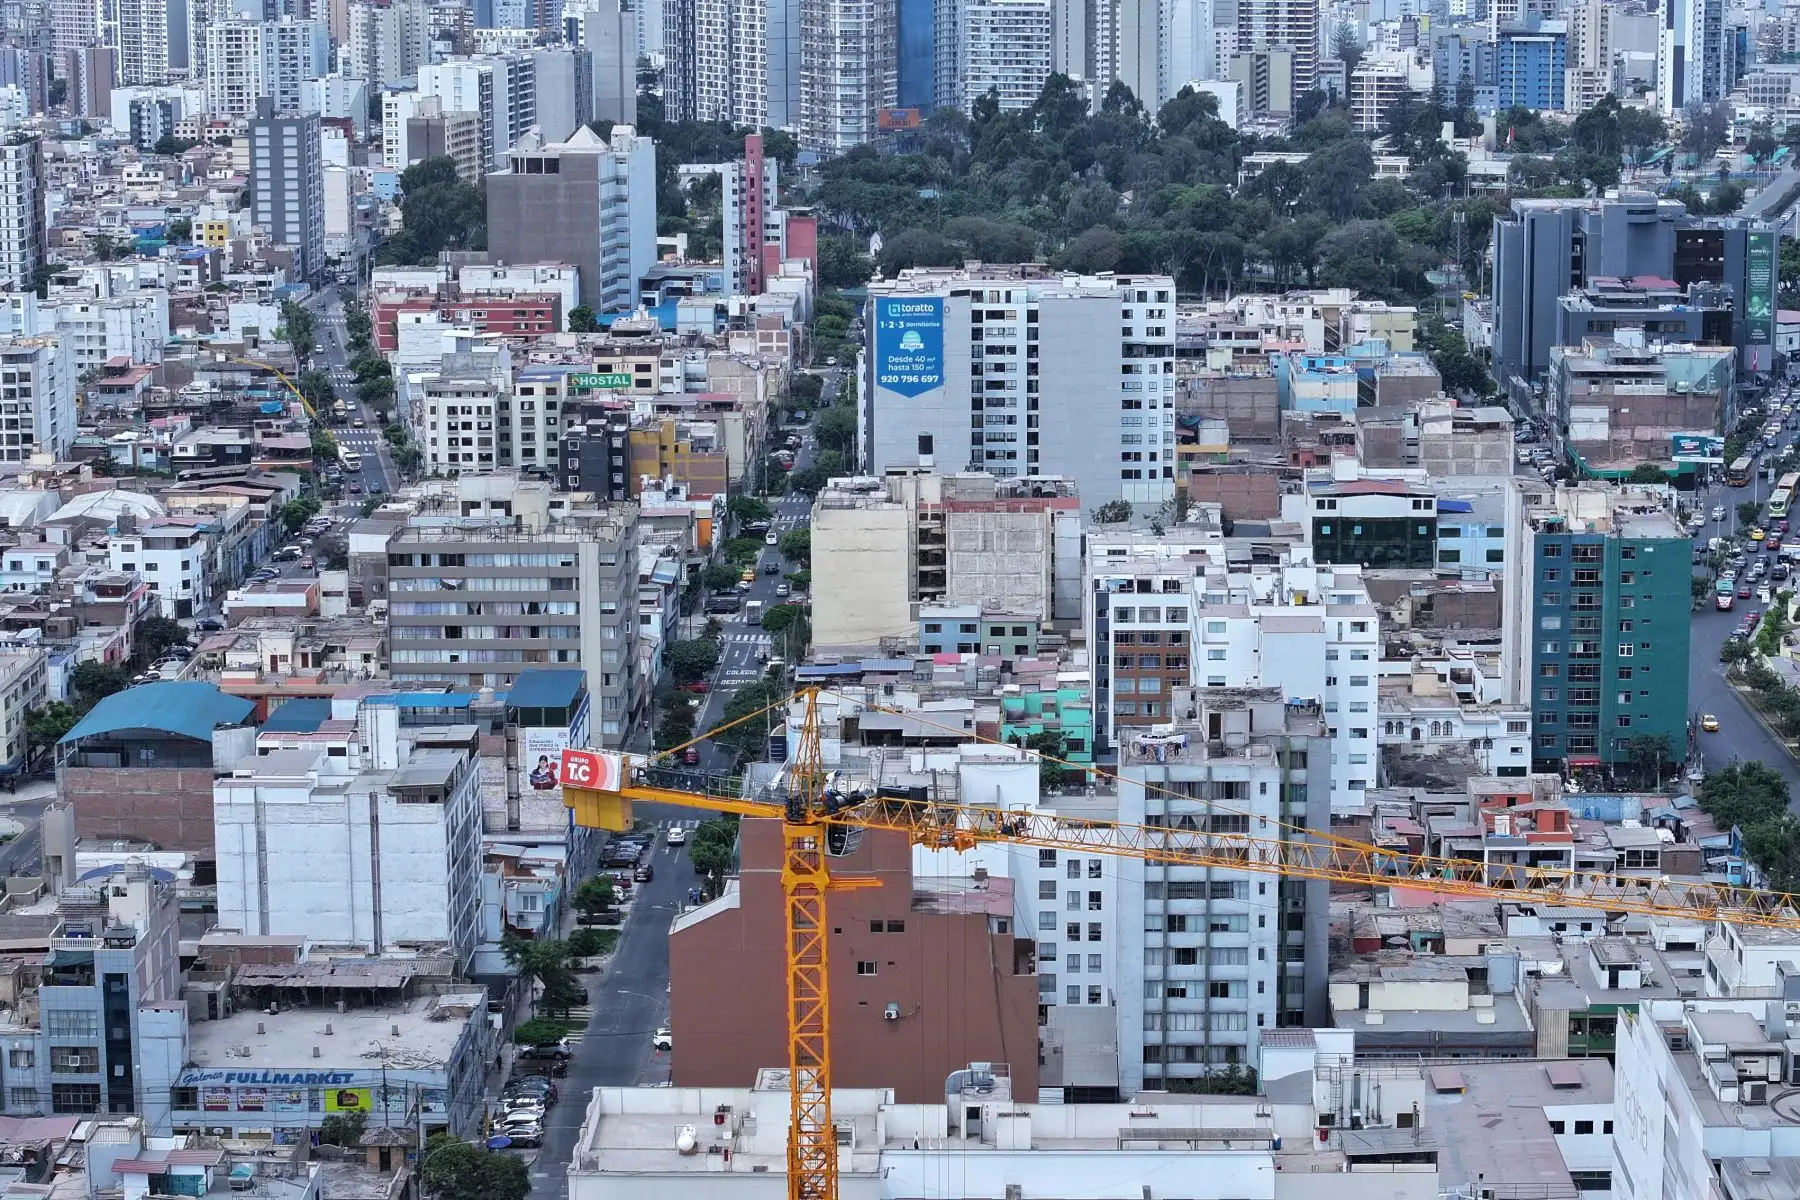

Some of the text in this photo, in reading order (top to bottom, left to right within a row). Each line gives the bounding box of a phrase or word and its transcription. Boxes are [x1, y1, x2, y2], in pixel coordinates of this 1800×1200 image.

[901, 303, 934, 312] toratto
[888, 355, 913, 363] Desde
[914, 355, 926, 363] 40
[888, 363, 910, 371] hasta
[911, 363, 925, 371] 150
[580, 375, 630, 386] HOSTAL
[881, 375, 939, 383] 920 796 697
[570, 756, 589, 764] GRUPO
[567, 762, 591, 782] T&C
[225, 1071, 354, 1085] FULLMARKET
